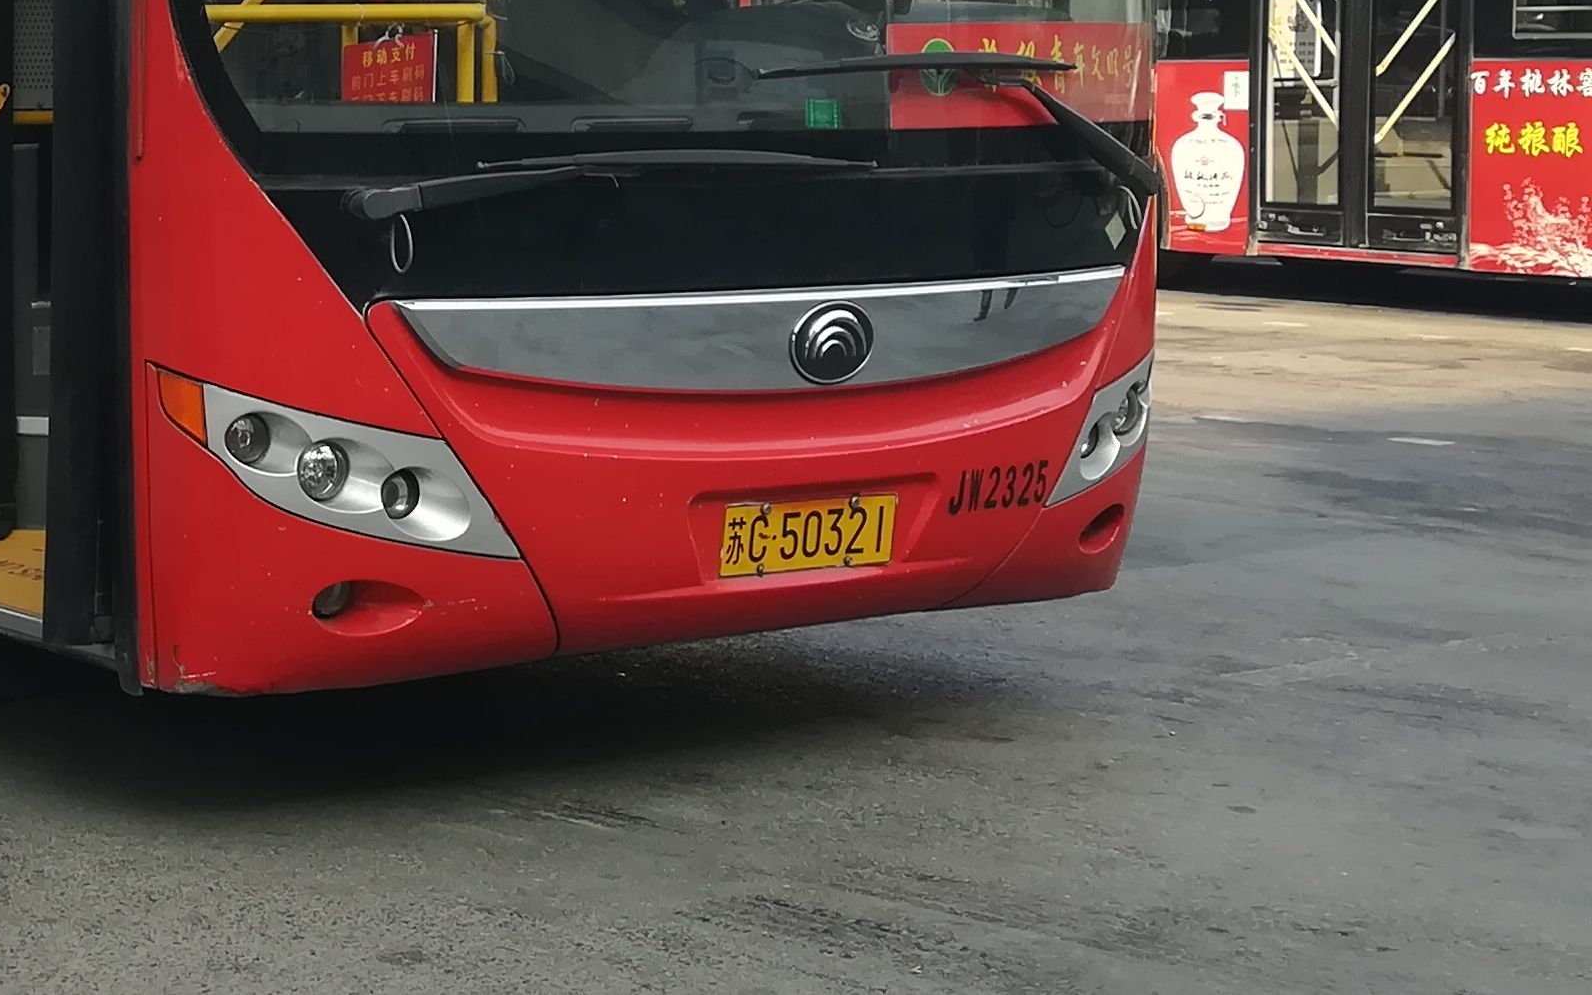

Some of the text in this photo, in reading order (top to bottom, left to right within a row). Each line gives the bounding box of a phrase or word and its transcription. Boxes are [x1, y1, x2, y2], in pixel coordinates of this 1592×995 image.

[361, 42, 416, 68] 移动支付
[1485, 121, 1584, 158] 纯粮酿
[948, 459, 1049, 515] JW2325
